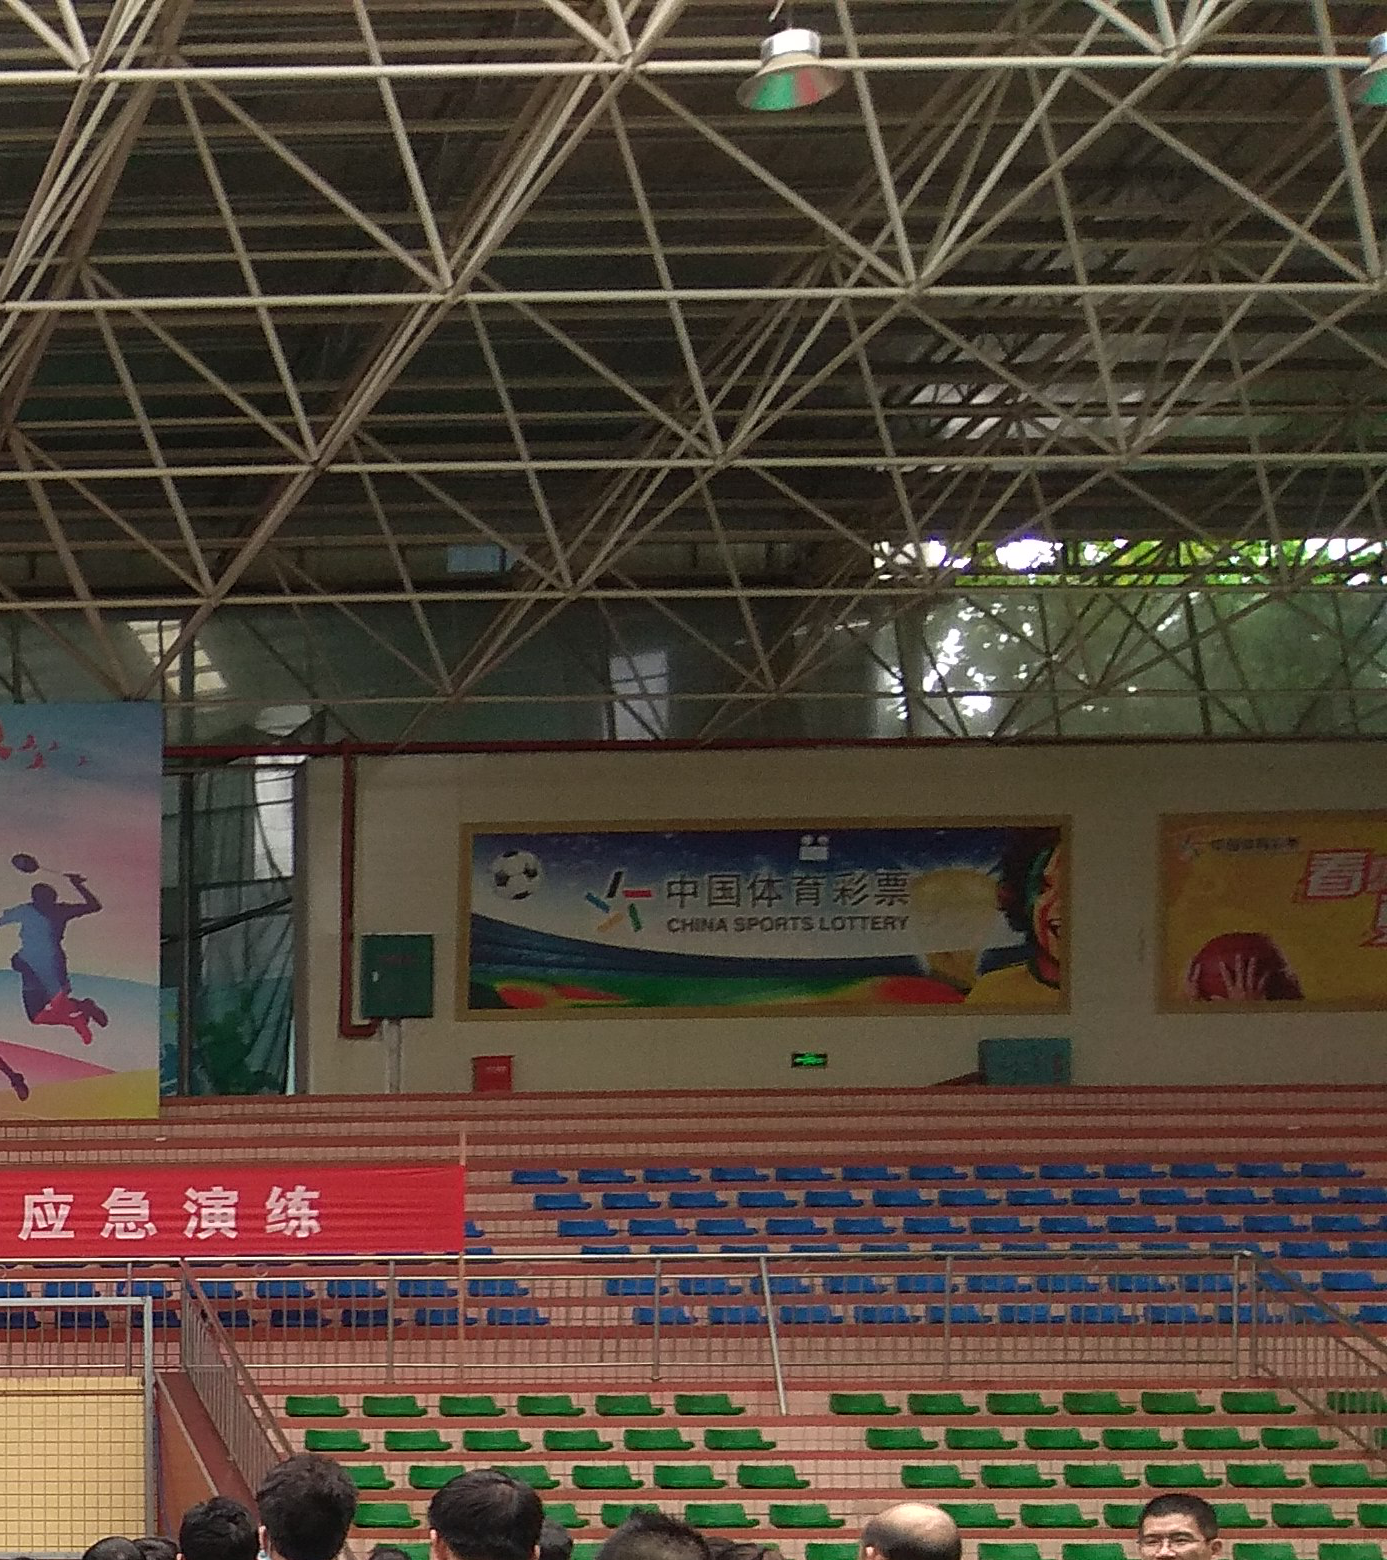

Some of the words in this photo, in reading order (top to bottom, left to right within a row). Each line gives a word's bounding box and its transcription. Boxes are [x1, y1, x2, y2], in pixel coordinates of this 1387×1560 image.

[666, 870, 911, 908] 中国体育彩票
[667, 917, 728, 933] CHINA
[734, 916, 814, 932] SPORTS
[819, 916, 909, 931] LOTTERY
